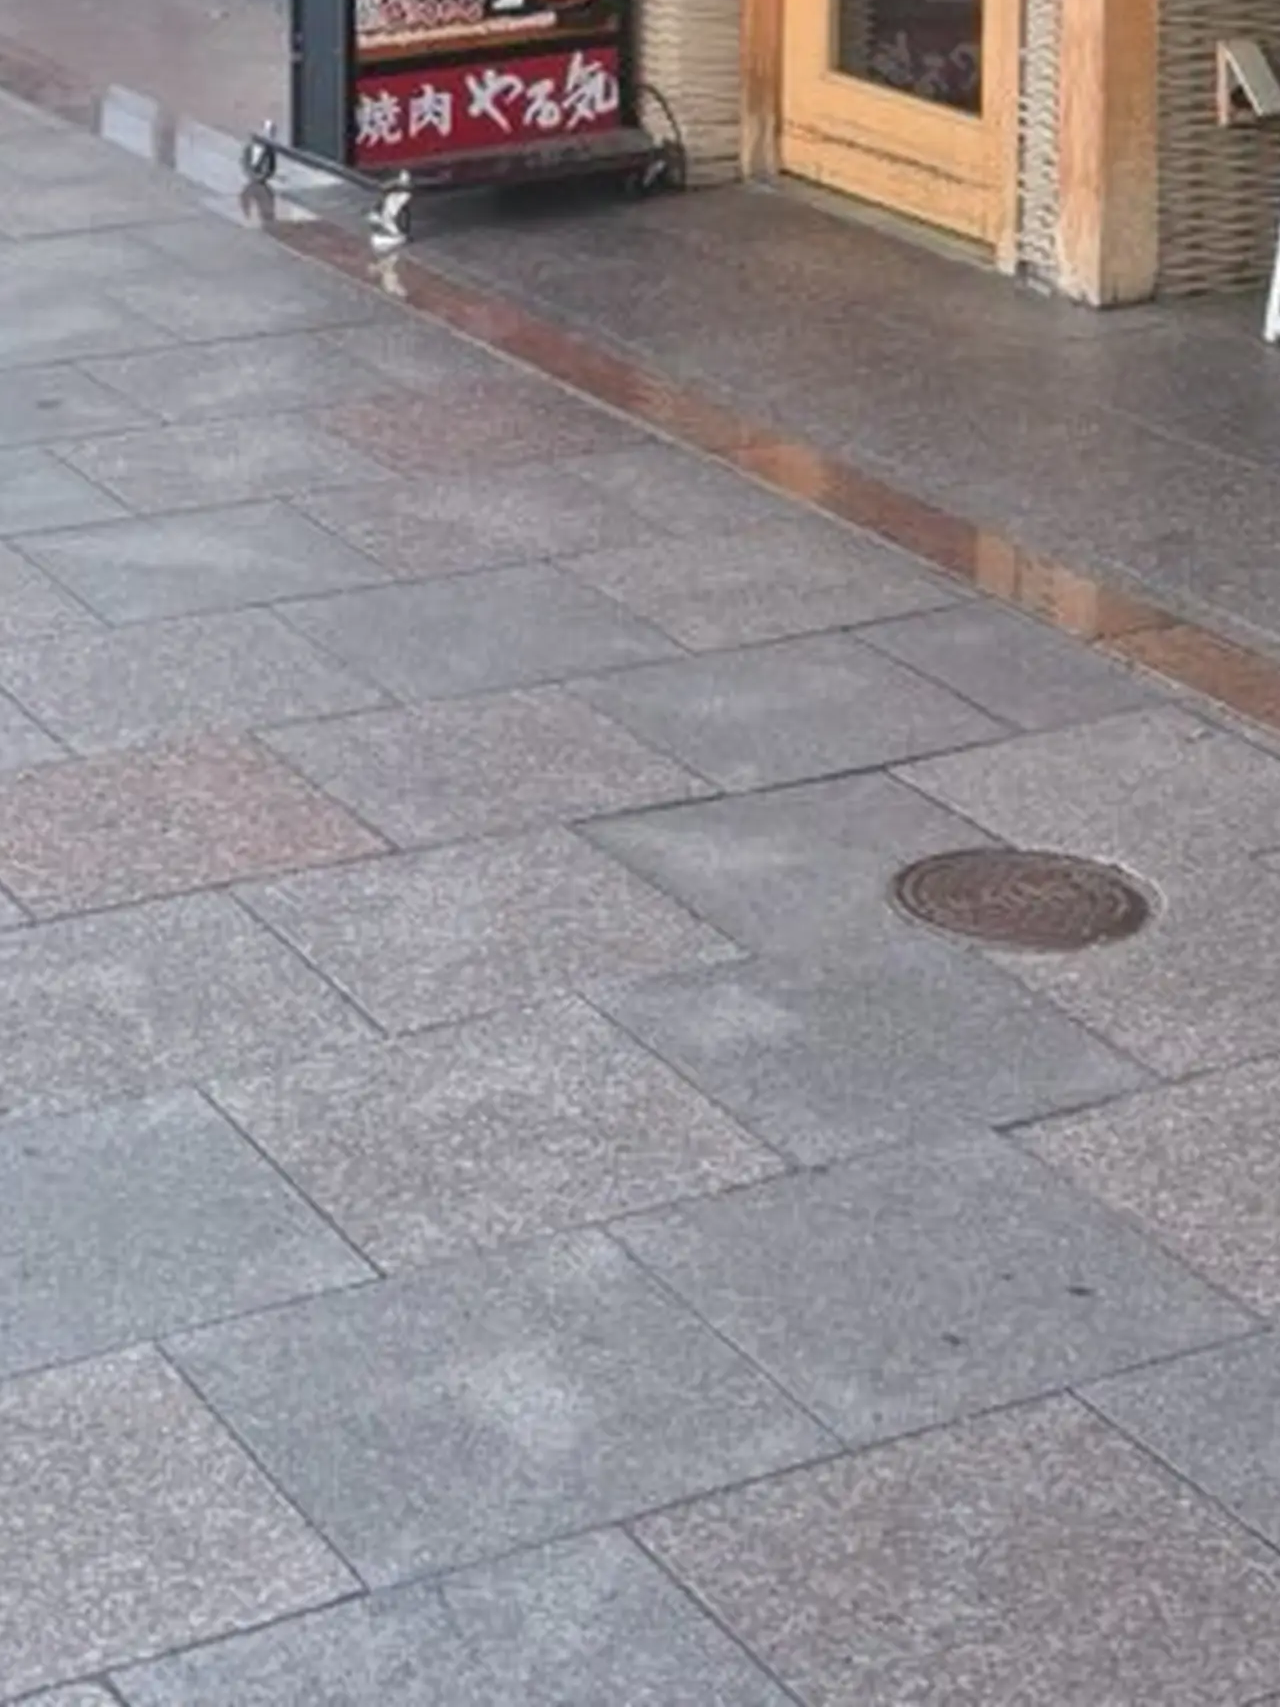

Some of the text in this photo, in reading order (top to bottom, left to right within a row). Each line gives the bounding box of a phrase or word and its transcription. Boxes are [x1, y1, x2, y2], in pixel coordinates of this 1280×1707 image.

[354, 50, 619, 149] 焼肉 やる気
